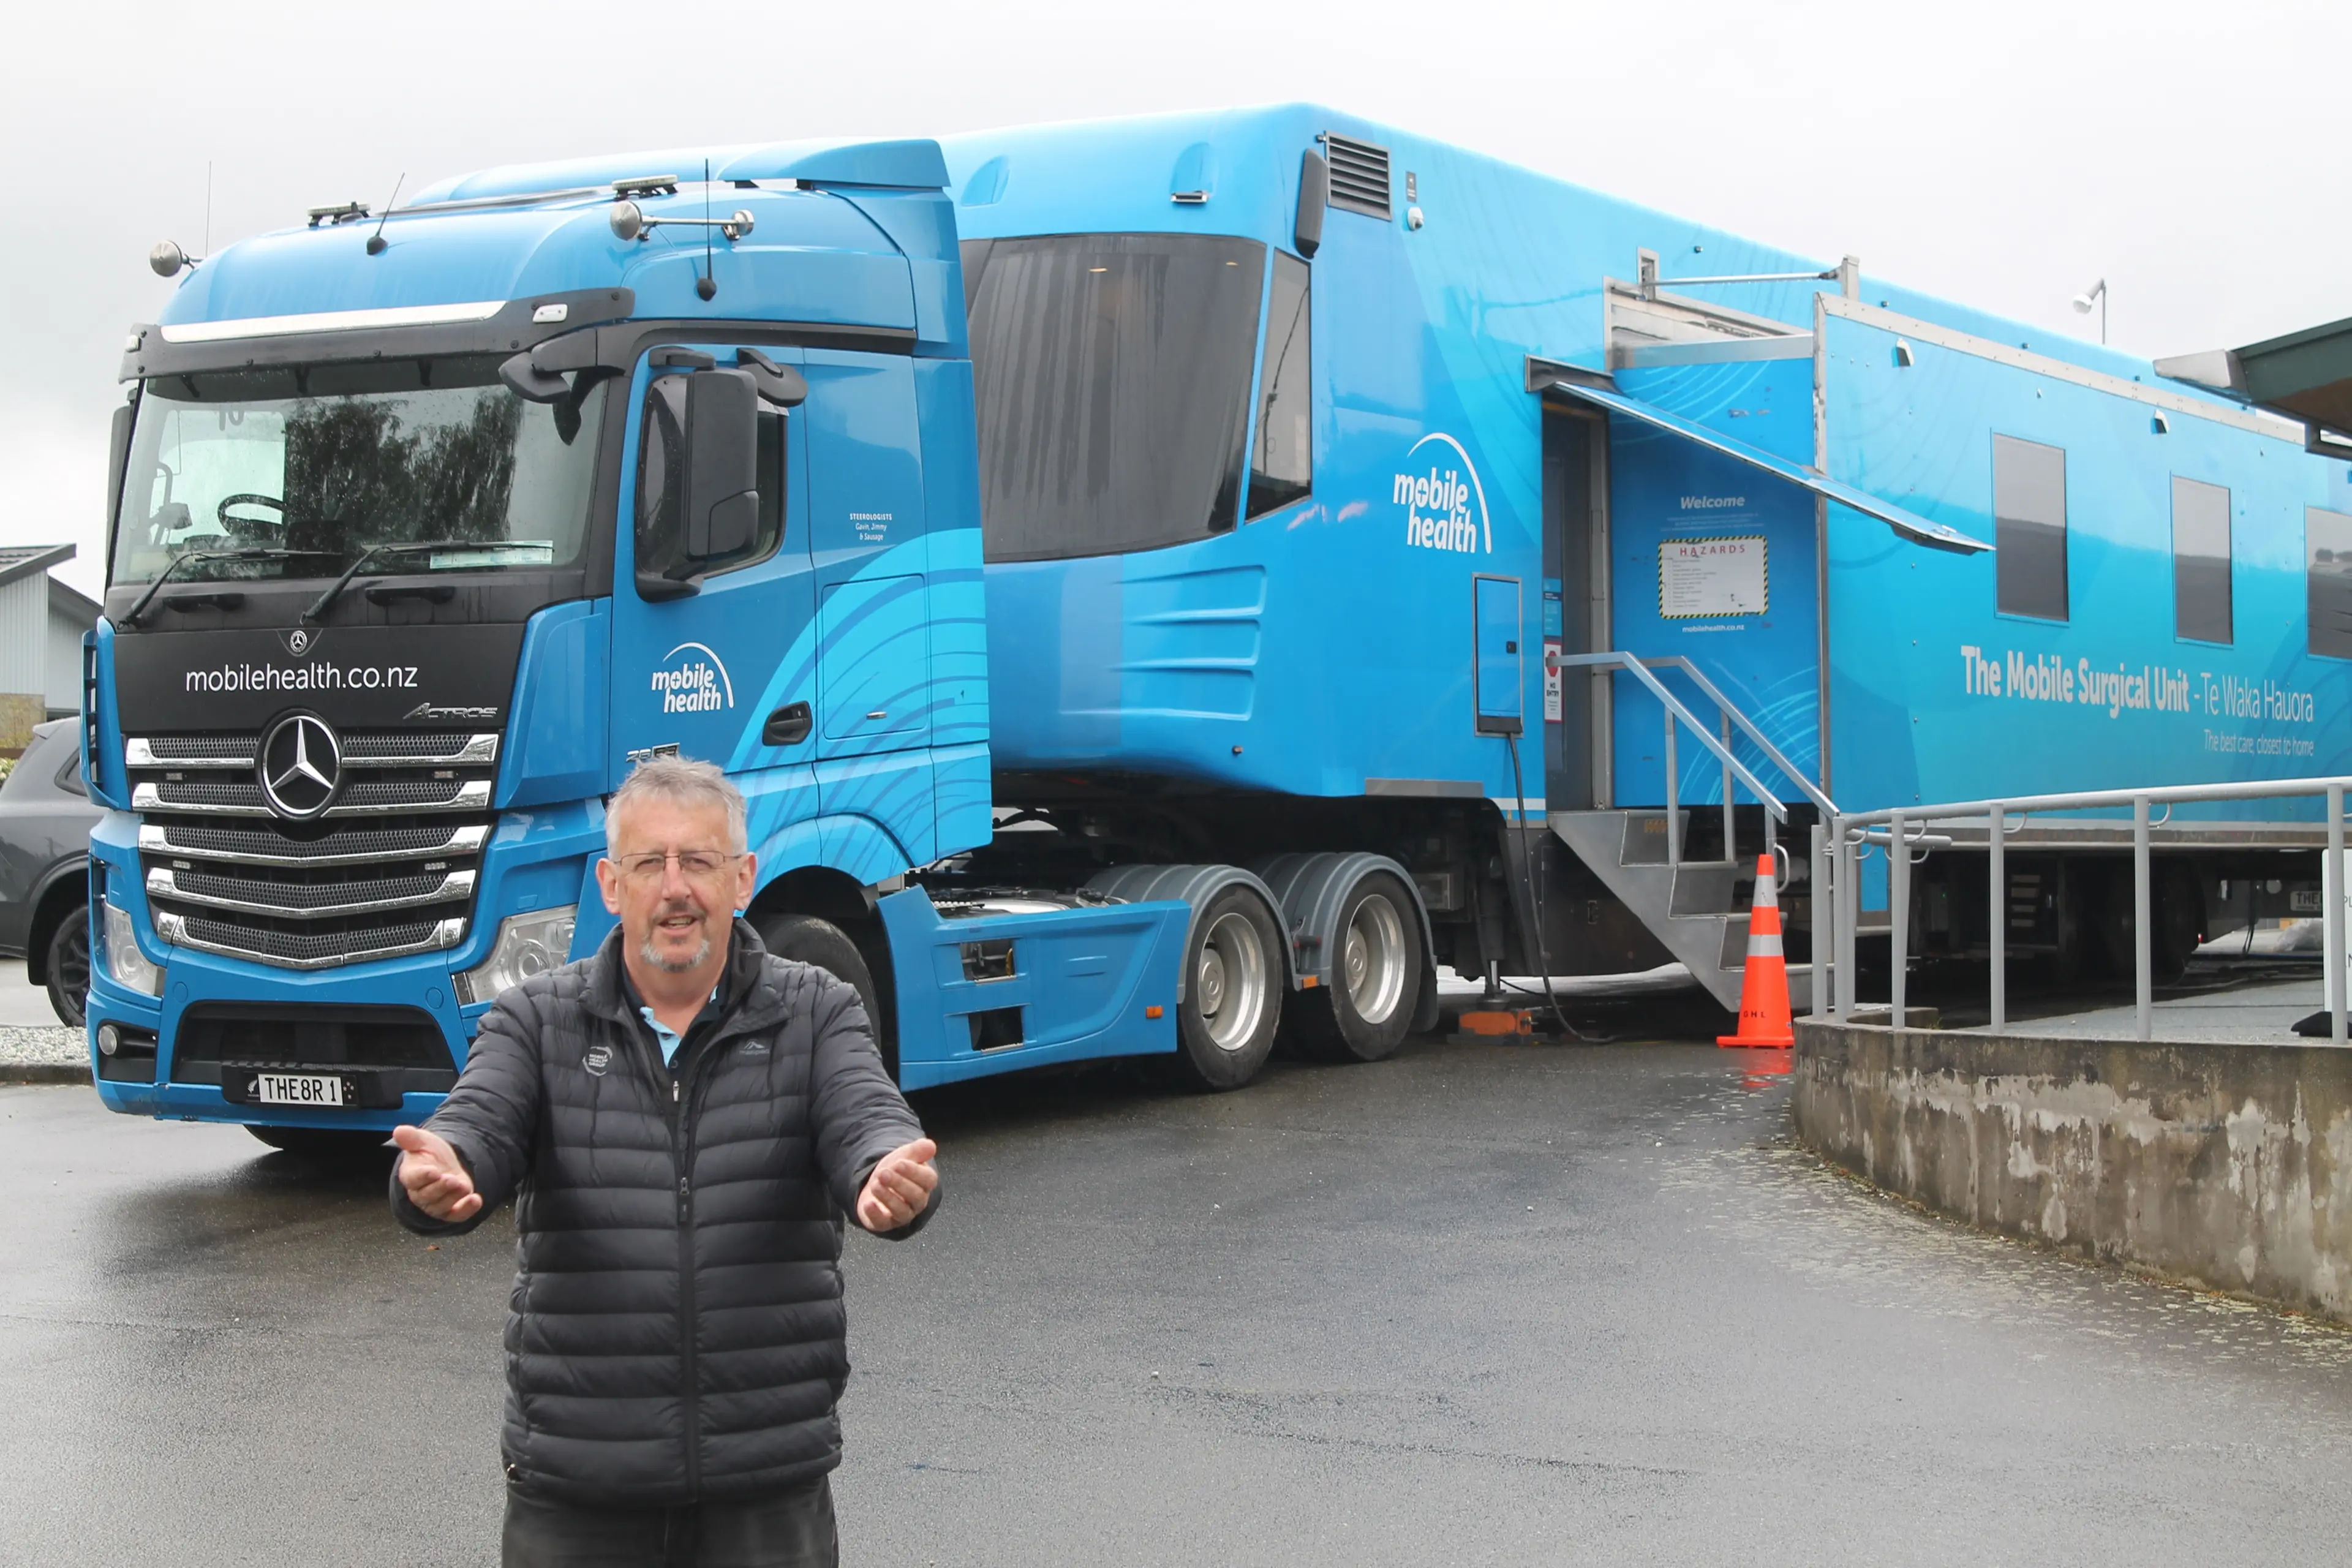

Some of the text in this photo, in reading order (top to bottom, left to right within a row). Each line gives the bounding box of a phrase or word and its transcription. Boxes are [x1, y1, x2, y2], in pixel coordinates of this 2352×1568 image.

[1393, 467, 1469, 514] mobile
[1681, 496, 1745, 510] Welcome
[864, 533, 883, 541] Sausage
[871, 522, 888, 532] Jimmy
[1407, 501, 1477, 554] health
[1679, 545, 1745, 557] HAZARDS
[1682, 624, 1745, 633] mobilehealth.co.nz
[186, 662, 418, 692] mobilehealth.co.nz
[652, 663, 714, 691] mobile
[1961, 645, 2001, 697] The
[2007, 650, 2073, 703] Mobile
[2078, 657, 2150, 719] Surgical
[2155, 666, 2189, 712] Unit
[2201, 672, 2220, 715] Te
[2222, 675, 2260, 719] Waka
[2264, 679, 2313, 723] Hauora
[663, 684, 722, 713] health
[2204, 728, 2314, 756] The best care, closest to home
[2296, 892, 2321, 905] THE
